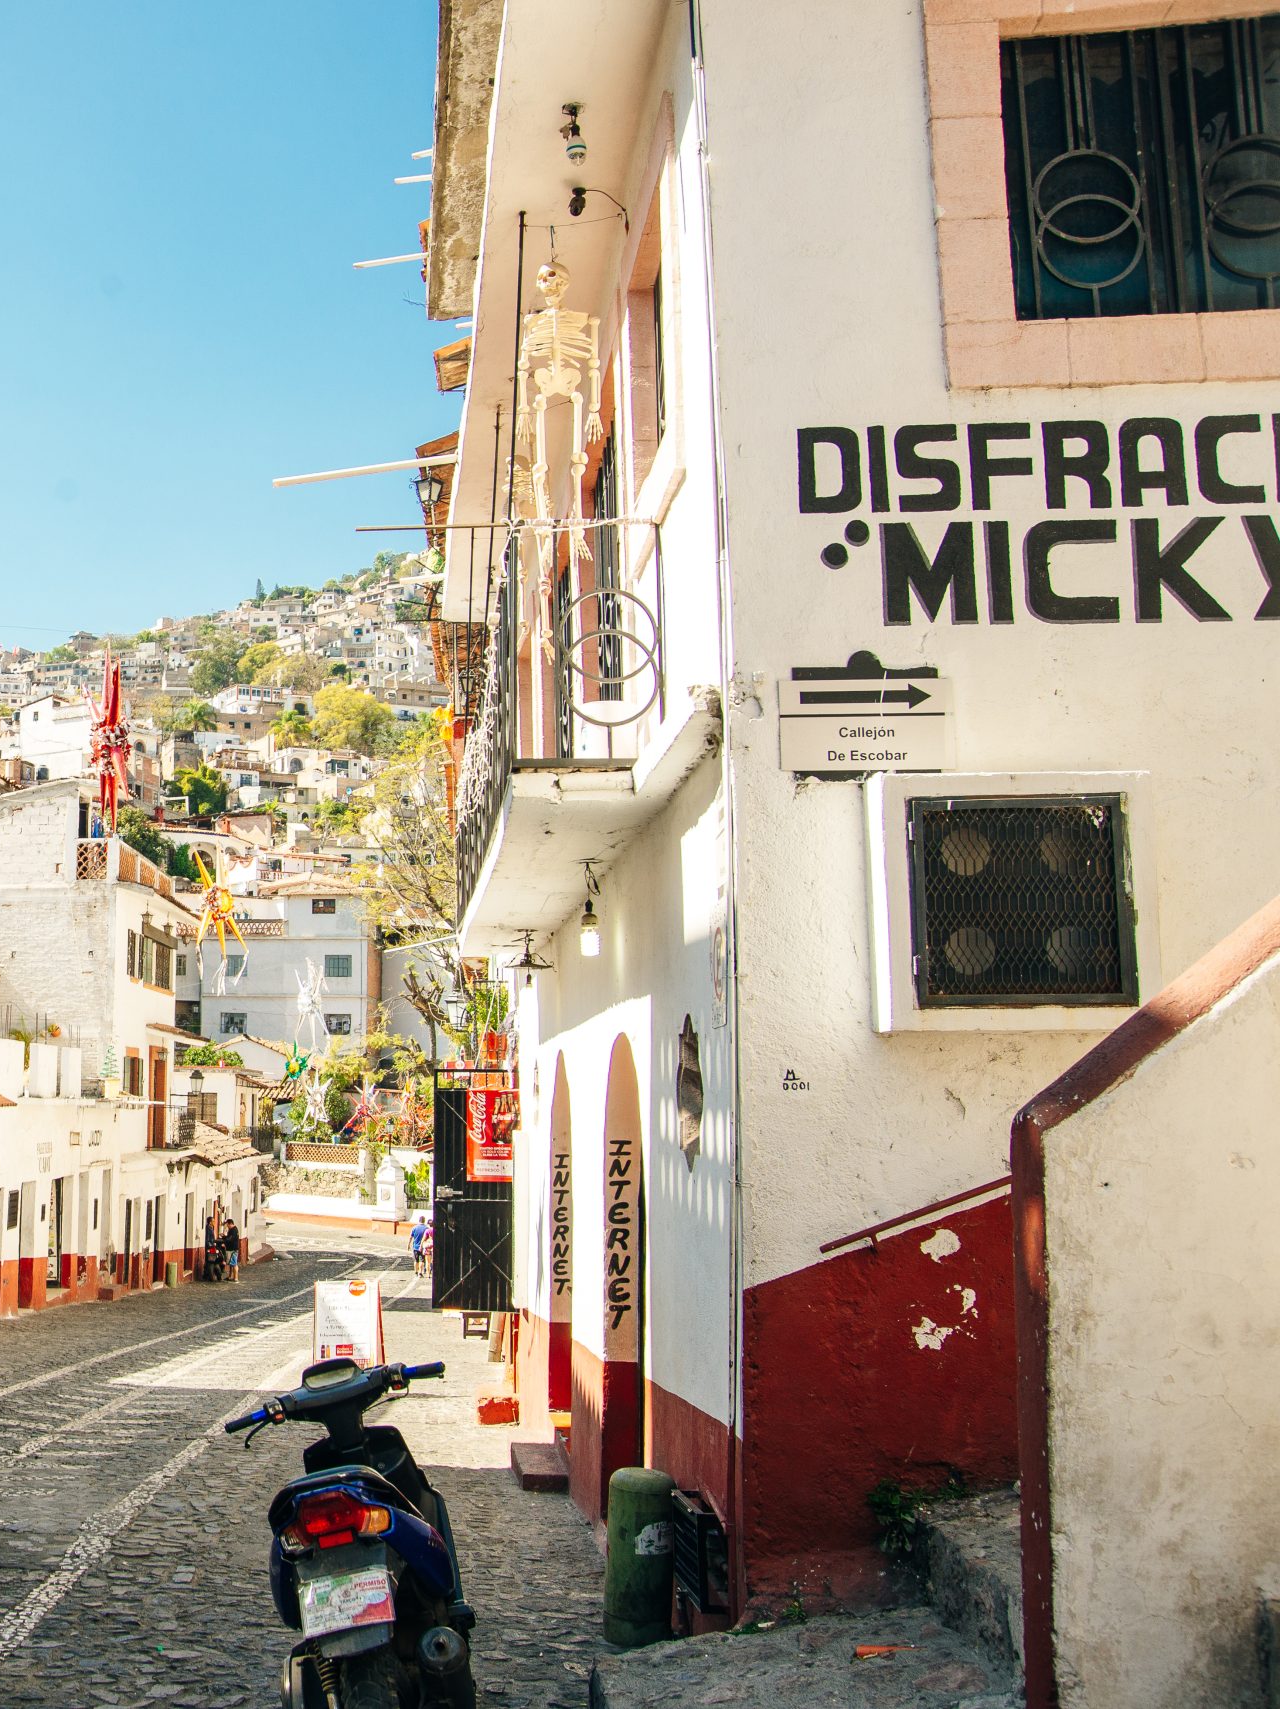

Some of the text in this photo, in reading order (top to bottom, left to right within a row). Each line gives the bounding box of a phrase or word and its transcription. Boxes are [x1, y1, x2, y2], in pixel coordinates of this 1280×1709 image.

[797, 413, 1280, 514] DISFRAC
[827, 750, 908, 761] De Escobar
[838, 726, 895, 740] Callejón
[553, 1154, 570, 1296] INTERNET
[607, 1139, 632, 1330] INTERNET
[353, 1579, 386, 1590] PERMISO
